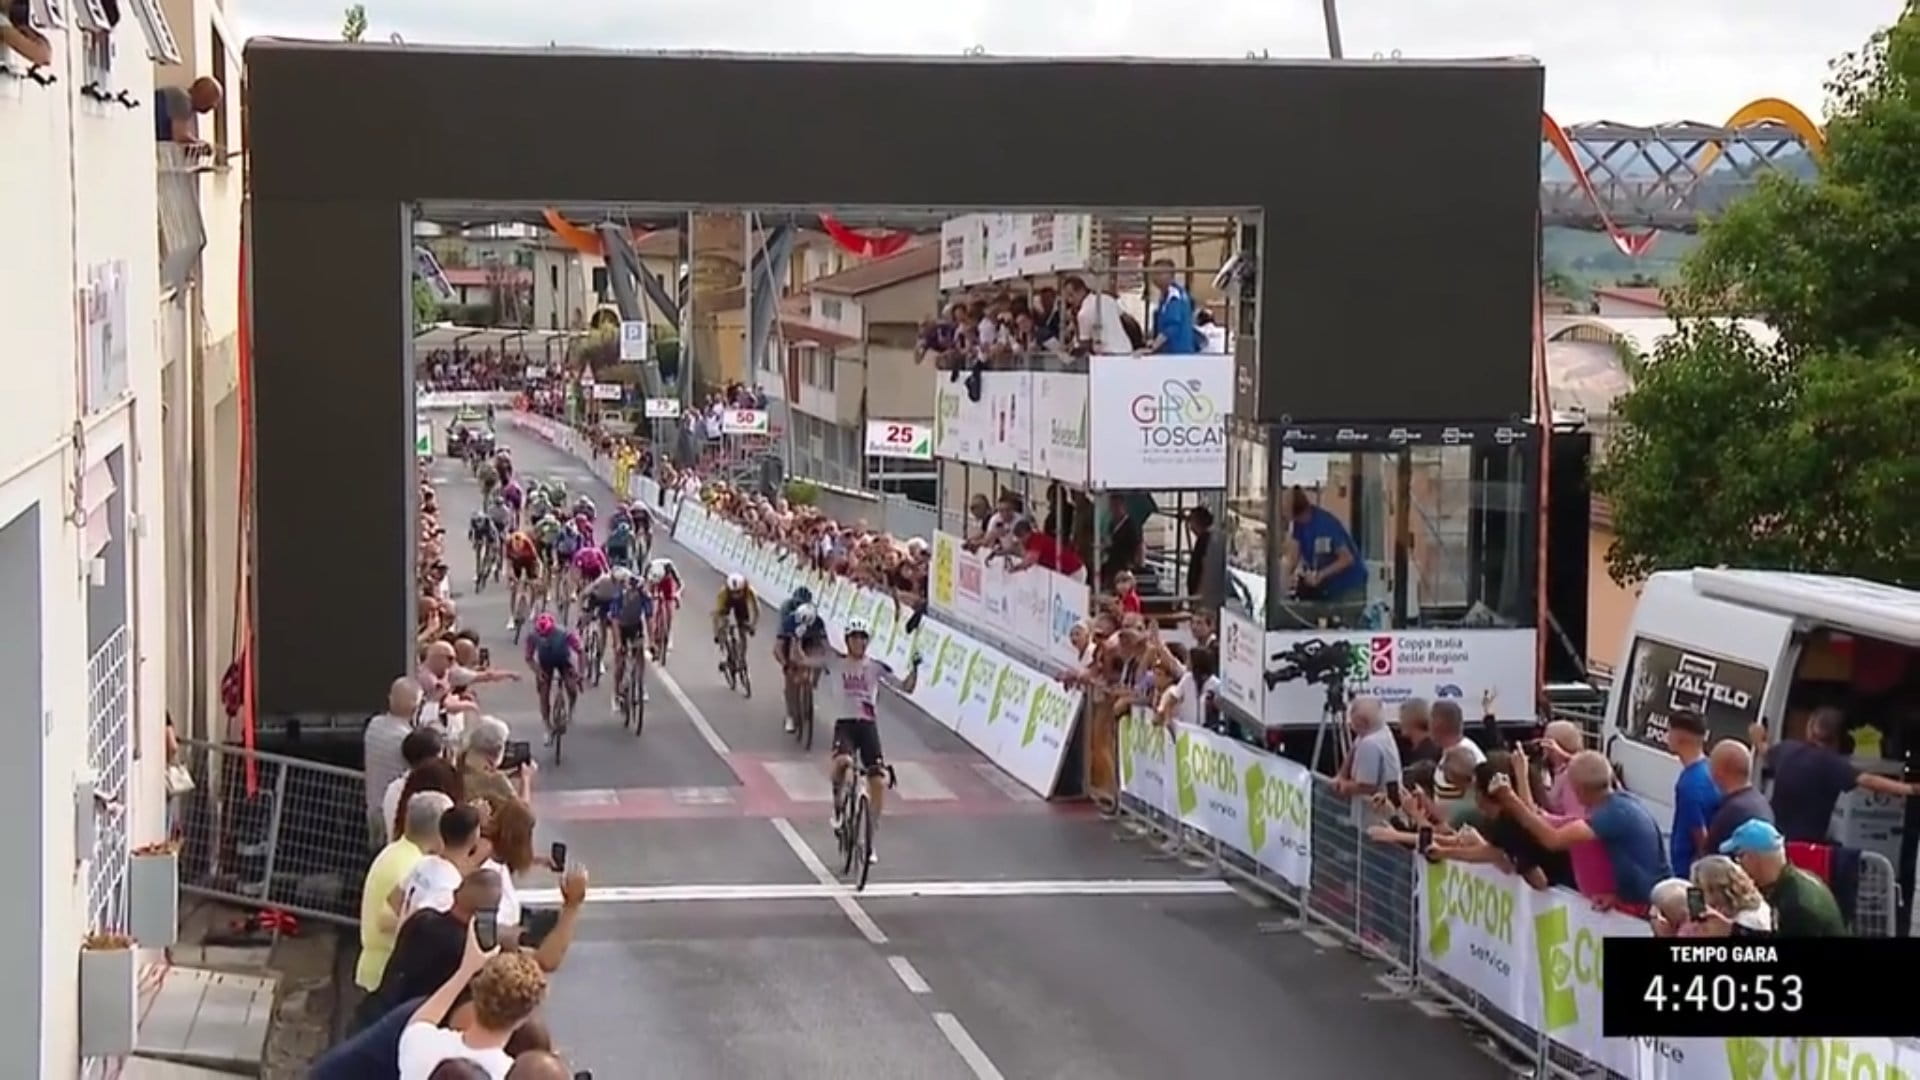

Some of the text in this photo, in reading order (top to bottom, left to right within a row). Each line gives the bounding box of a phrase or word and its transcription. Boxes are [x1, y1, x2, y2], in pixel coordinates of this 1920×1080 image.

[736, 412, 755, 424] 50
[1131, 394, 1213, 424] GIRO
[887, 425, 912, 443] 25
[1667, 670, 1749, 709] ITALTELO
[1450, 865, 1514, 945] COFOR
